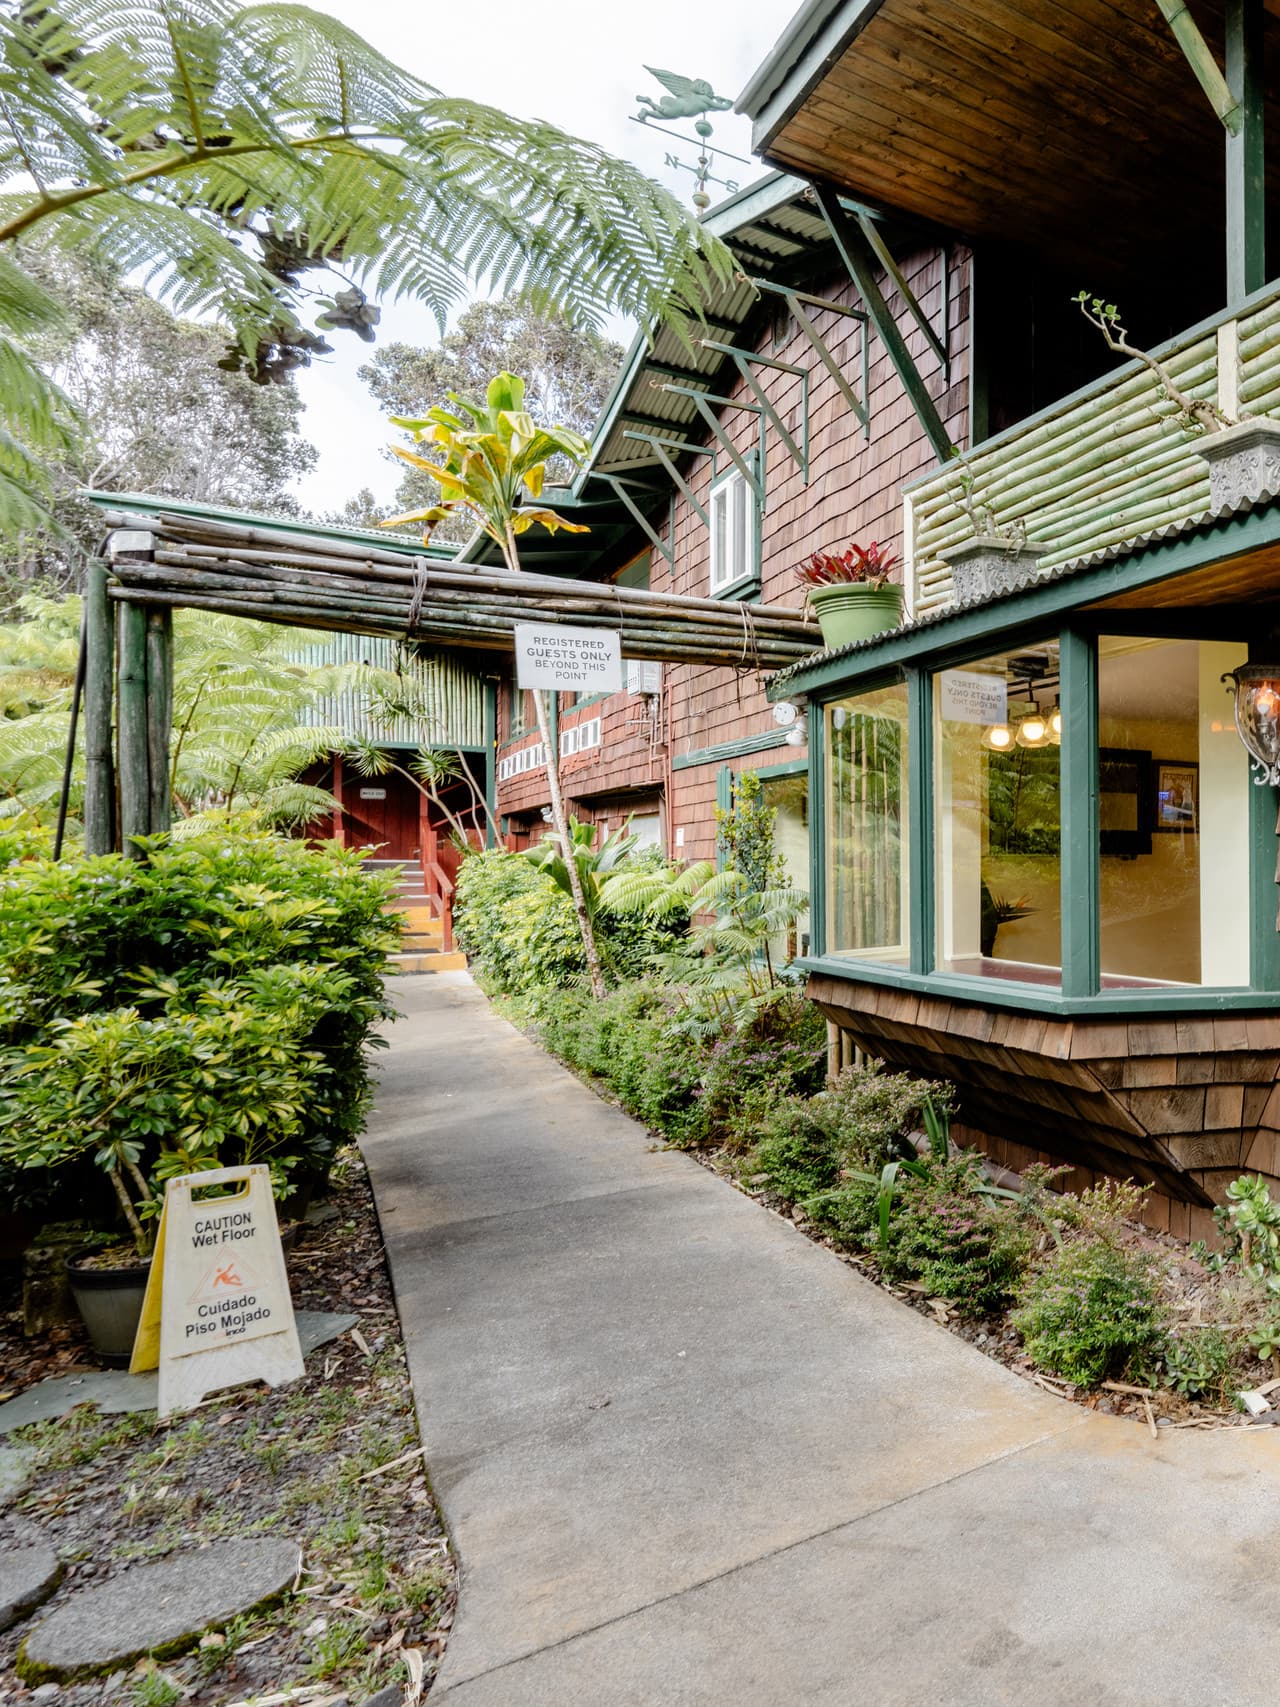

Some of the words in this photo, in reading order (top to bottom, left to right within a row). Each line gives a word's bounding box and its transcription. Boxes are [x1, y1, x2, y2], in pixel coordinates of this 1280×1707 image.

[533, 636, 604, 649] REGISTERED
[527, 647, 576, 659] GUESTS
[580, 651, 612, 661] ONLY
[535, 659, 579, 670] BEYOND
[582, 662, 606, 672] THIS
[555, 671, 587, 680] POINT
[195, 1212, 252, 1234] CAUTION
[192, 1234, 218, 1248] Wet
[222, 1227, 256, 1242] Floor
[198, 1295, 256, 1317] Cuidado
[185, 1321, 216, 1337] Piso
[221, 1307, 270, 1328] Mojado
